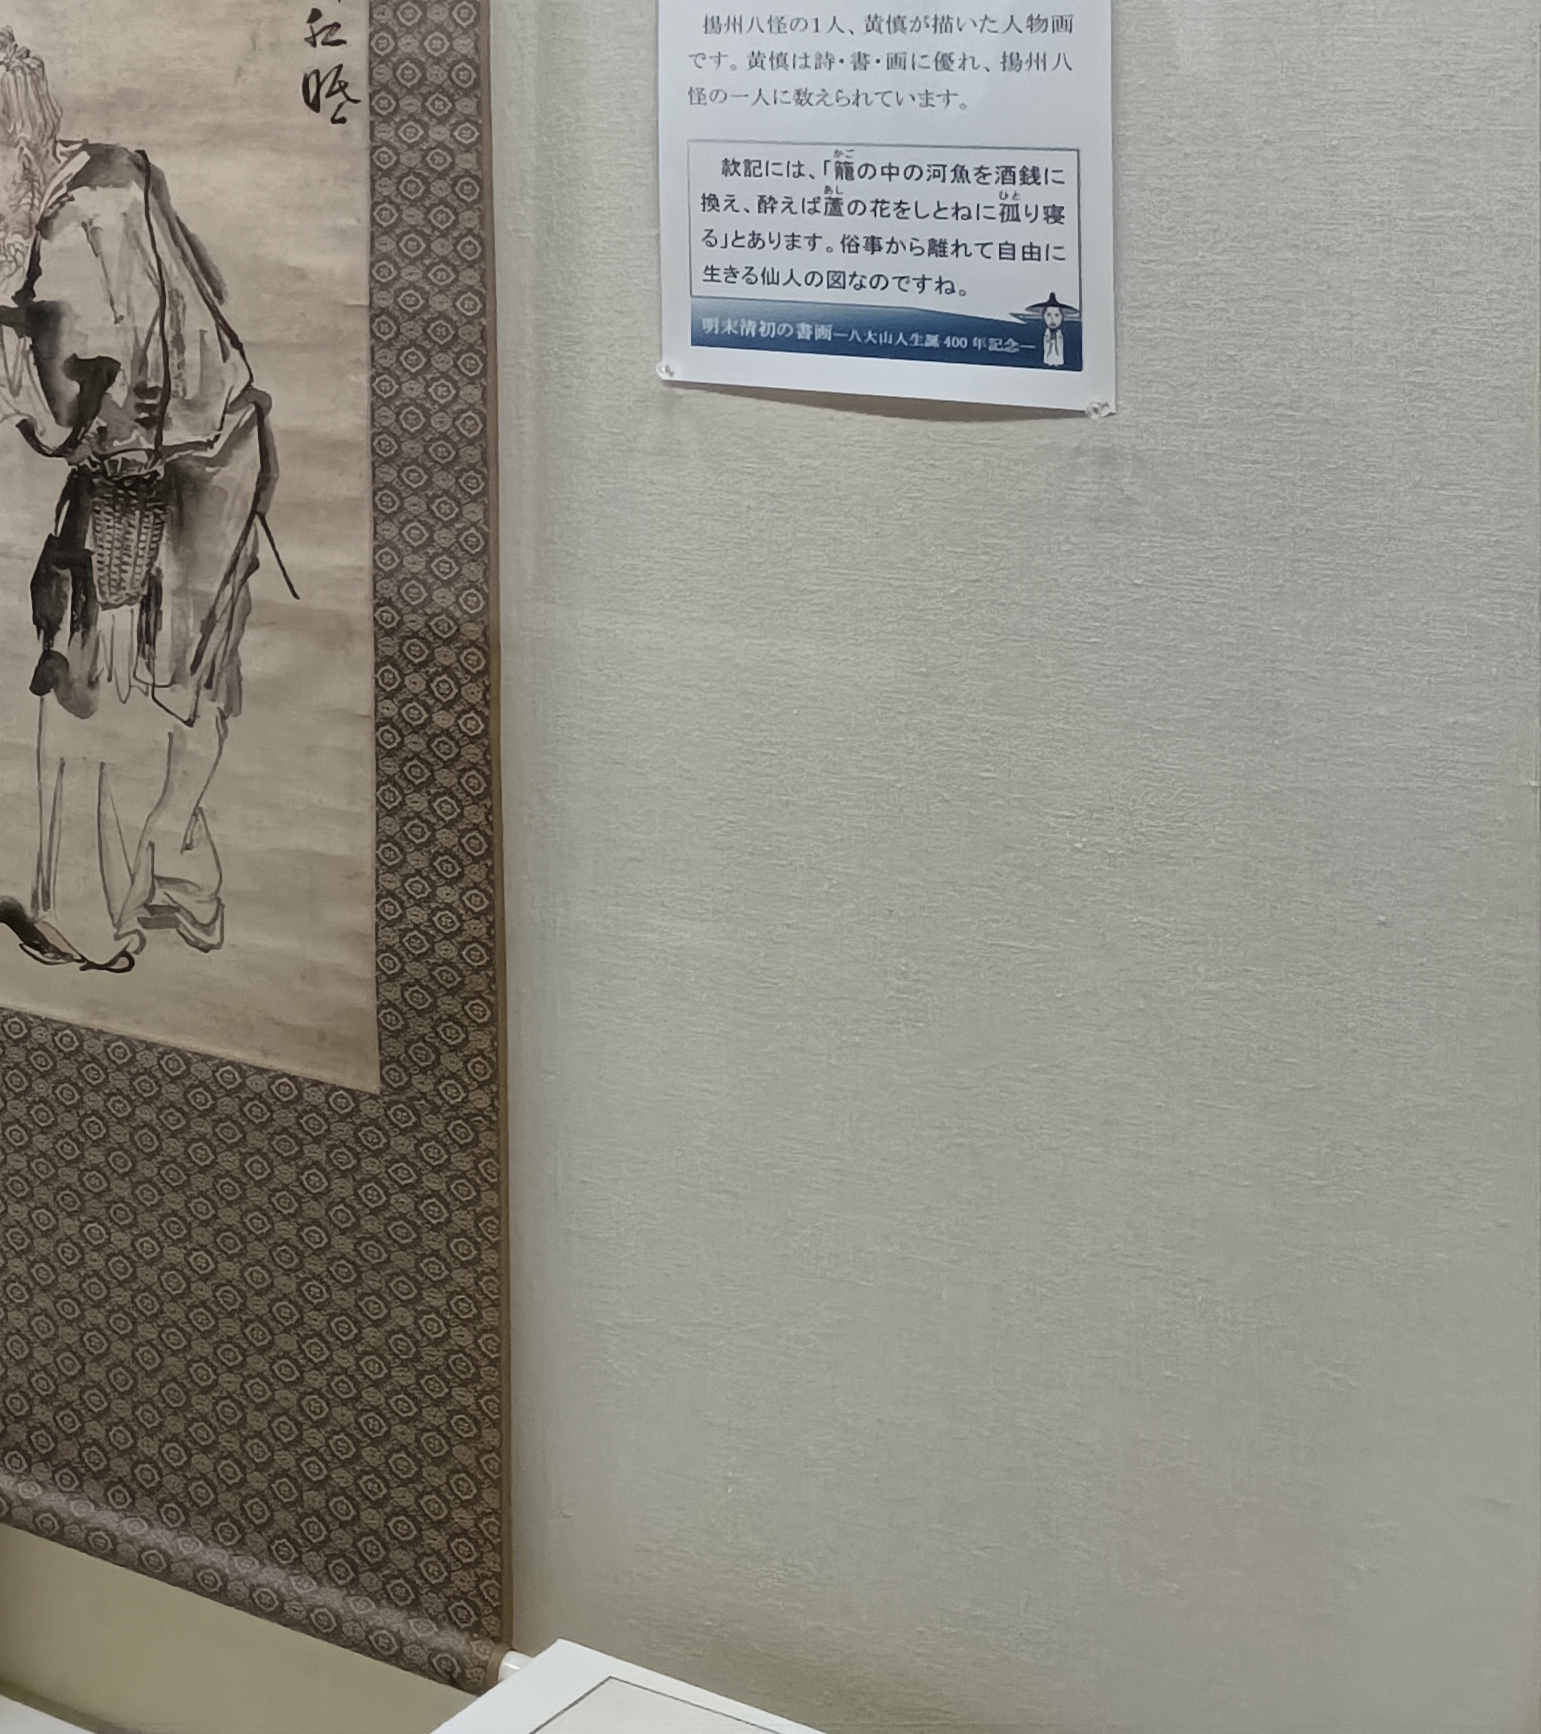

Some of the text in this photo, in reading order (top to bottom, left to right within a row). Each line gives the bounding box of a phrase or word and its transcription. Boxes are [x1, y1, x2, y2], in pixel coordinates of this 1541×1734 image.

[688, 87, 968, 110] 怪の一人に数えられています。
[701, 229, 1067, 263] る」とあります。俗事から離れて自由に
[701, 265, 968, 297] 生きる仙人の図なのですね。
